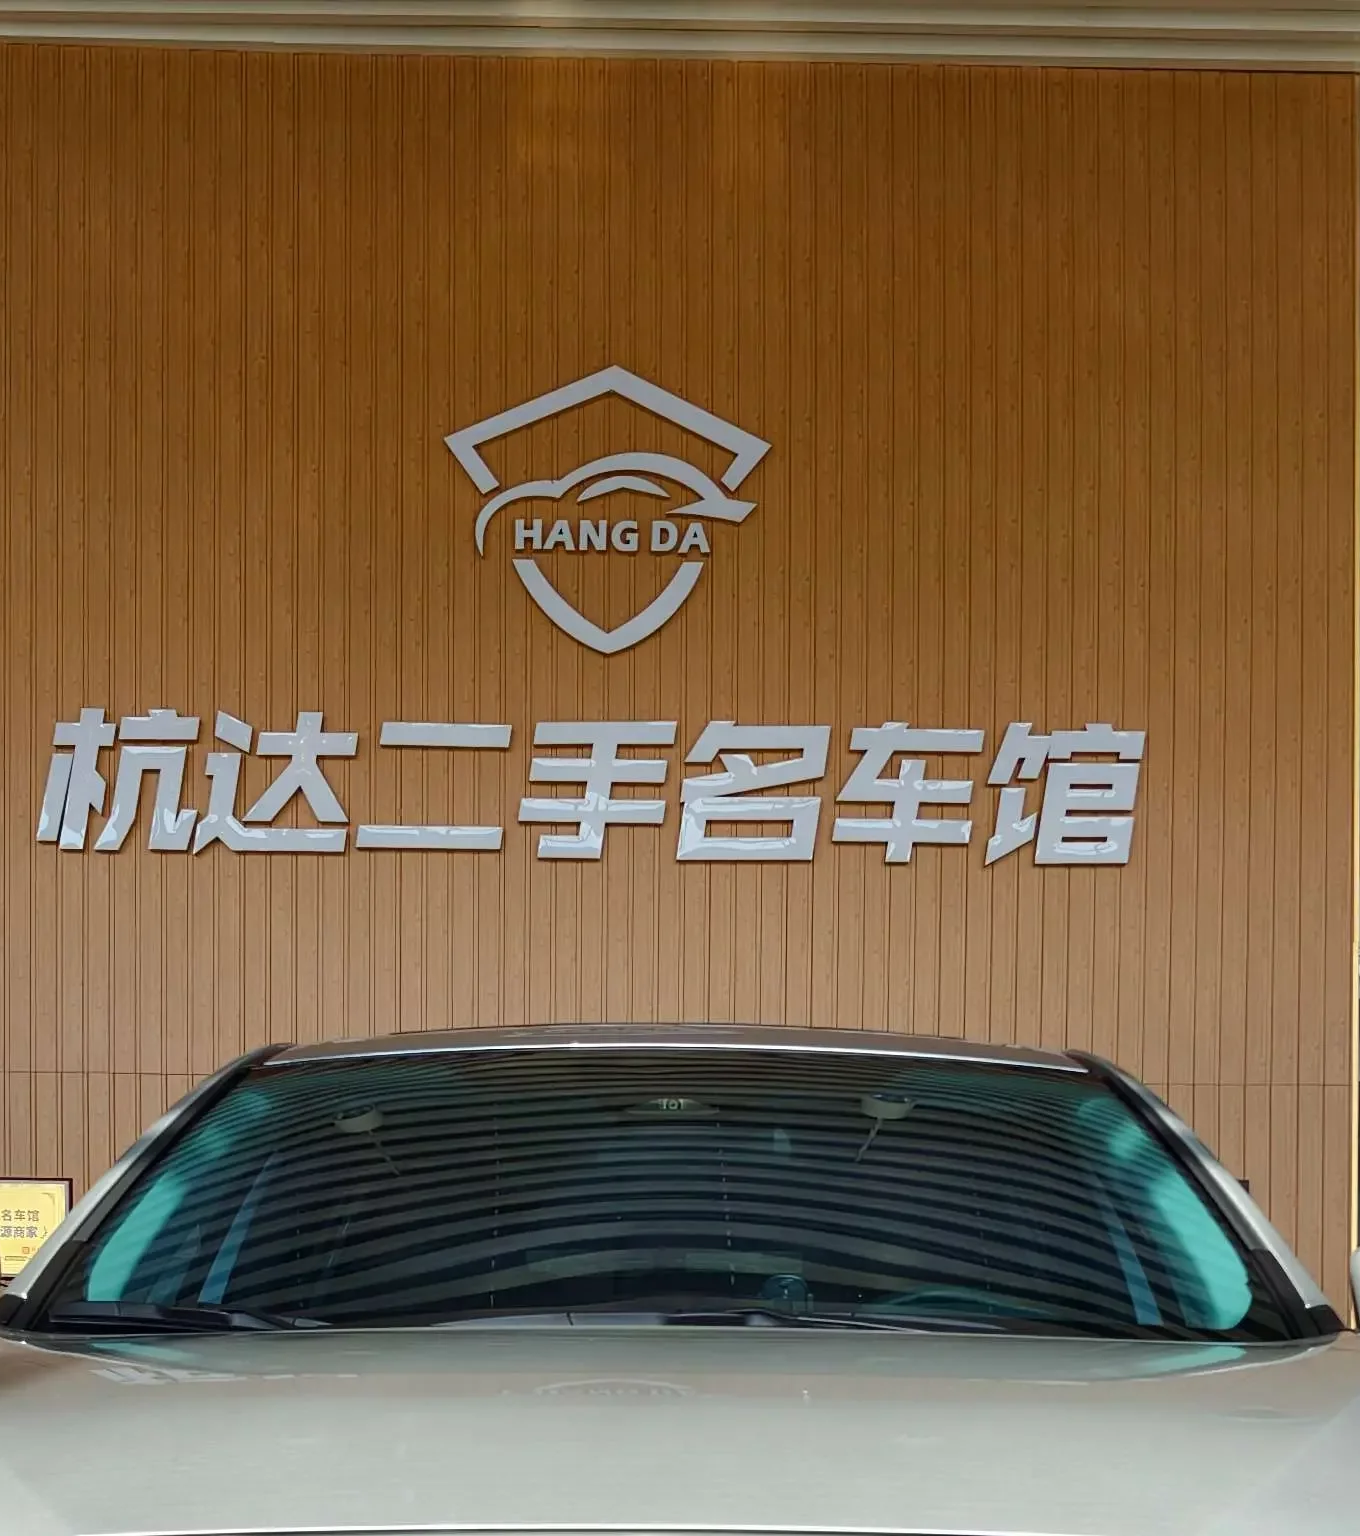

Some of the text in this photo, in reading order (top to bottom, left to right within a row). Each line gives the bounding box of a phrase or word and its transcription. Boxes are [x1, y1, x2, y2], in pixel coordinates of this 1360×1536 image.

[513, 517, 711, 555] HANG DA
[36, 706, 1147, 867] 杭达二手名车馆
